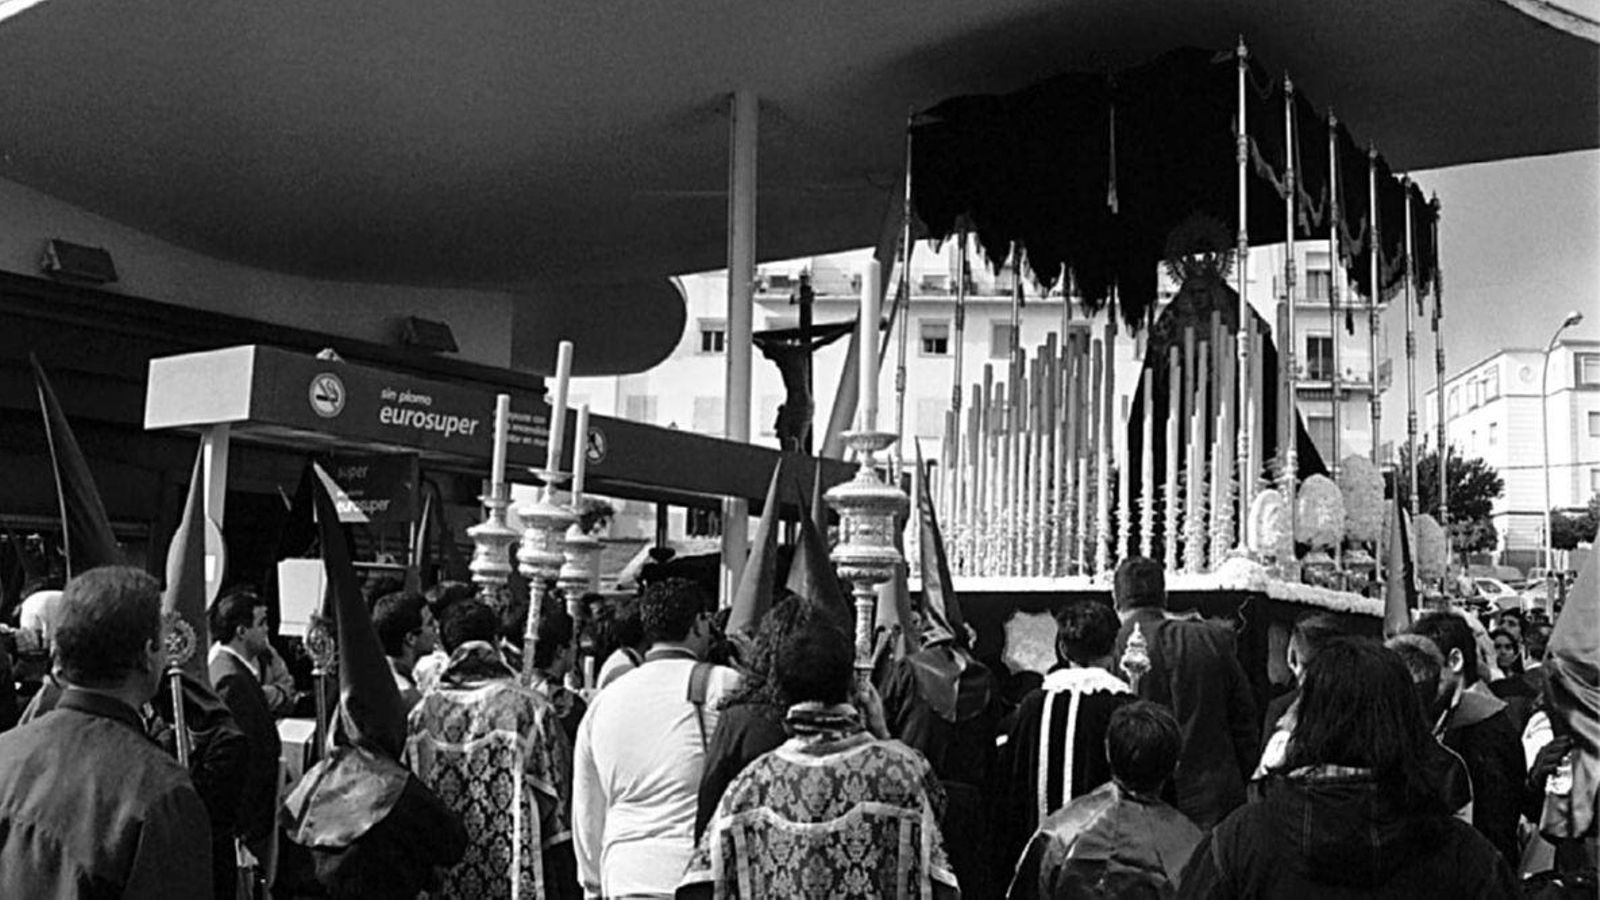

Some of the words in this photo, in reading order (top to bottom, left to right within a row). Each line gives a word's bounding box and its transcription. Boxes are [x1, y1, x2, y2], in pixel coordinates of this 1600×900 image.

[381, 387, 397, 400] sin
[398, 389, 432, 406] plomo
[380, 406, 479, 438] eurosuper
